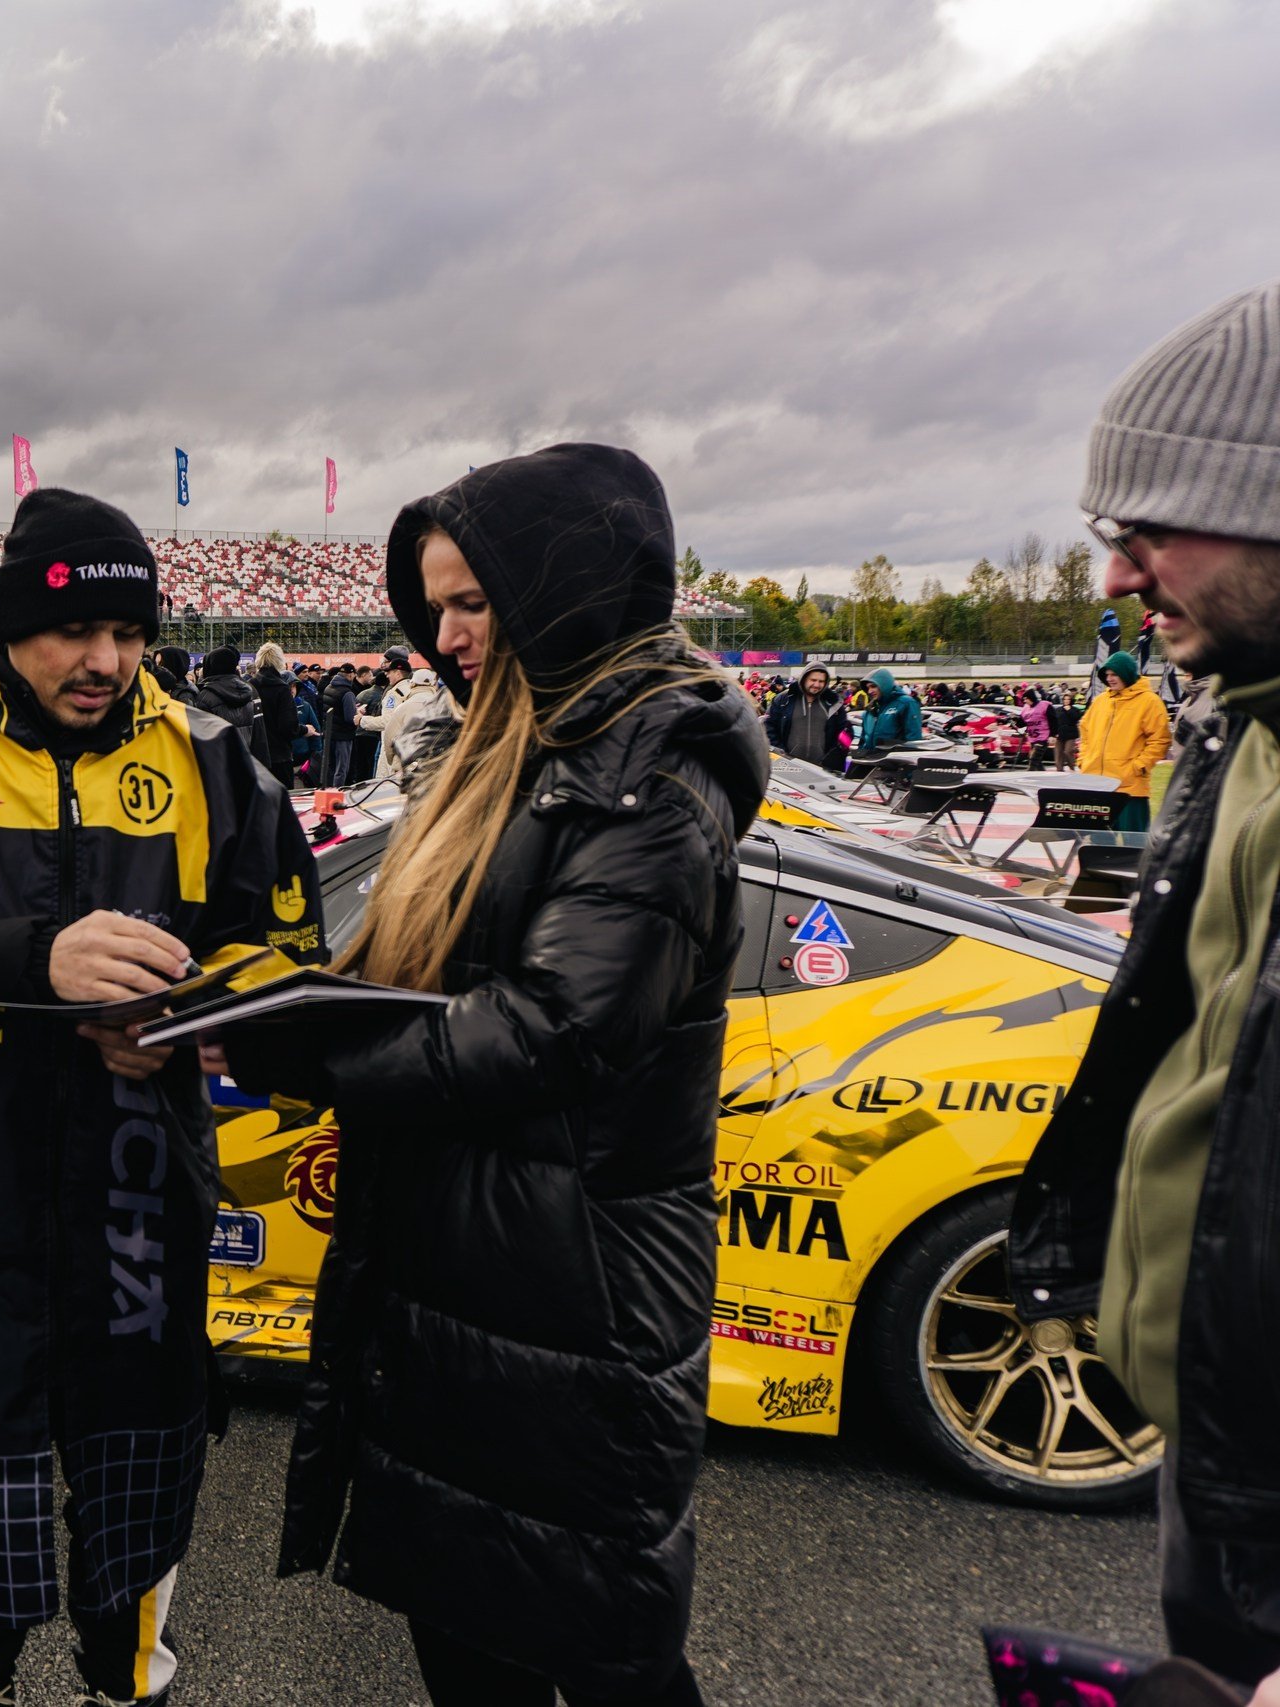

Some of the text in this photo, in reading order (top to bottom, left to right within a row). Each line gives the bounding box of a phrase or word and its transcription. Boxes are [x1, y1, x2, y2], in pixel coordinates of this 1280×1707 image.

[128, 774, 155, 811] 31
[1045, 802, 1111, 814] FORWARD
[1045, 812, 1110, 821] RACING
[794, 1165, 843, 1188] OIL
[717, 1189, 852, 1262] MA
[211, 1311, 297, 1331] АВТО
[713, 1299, 839, 1337] SSOL
[752, 1329, 831, 1352] WHEELS
